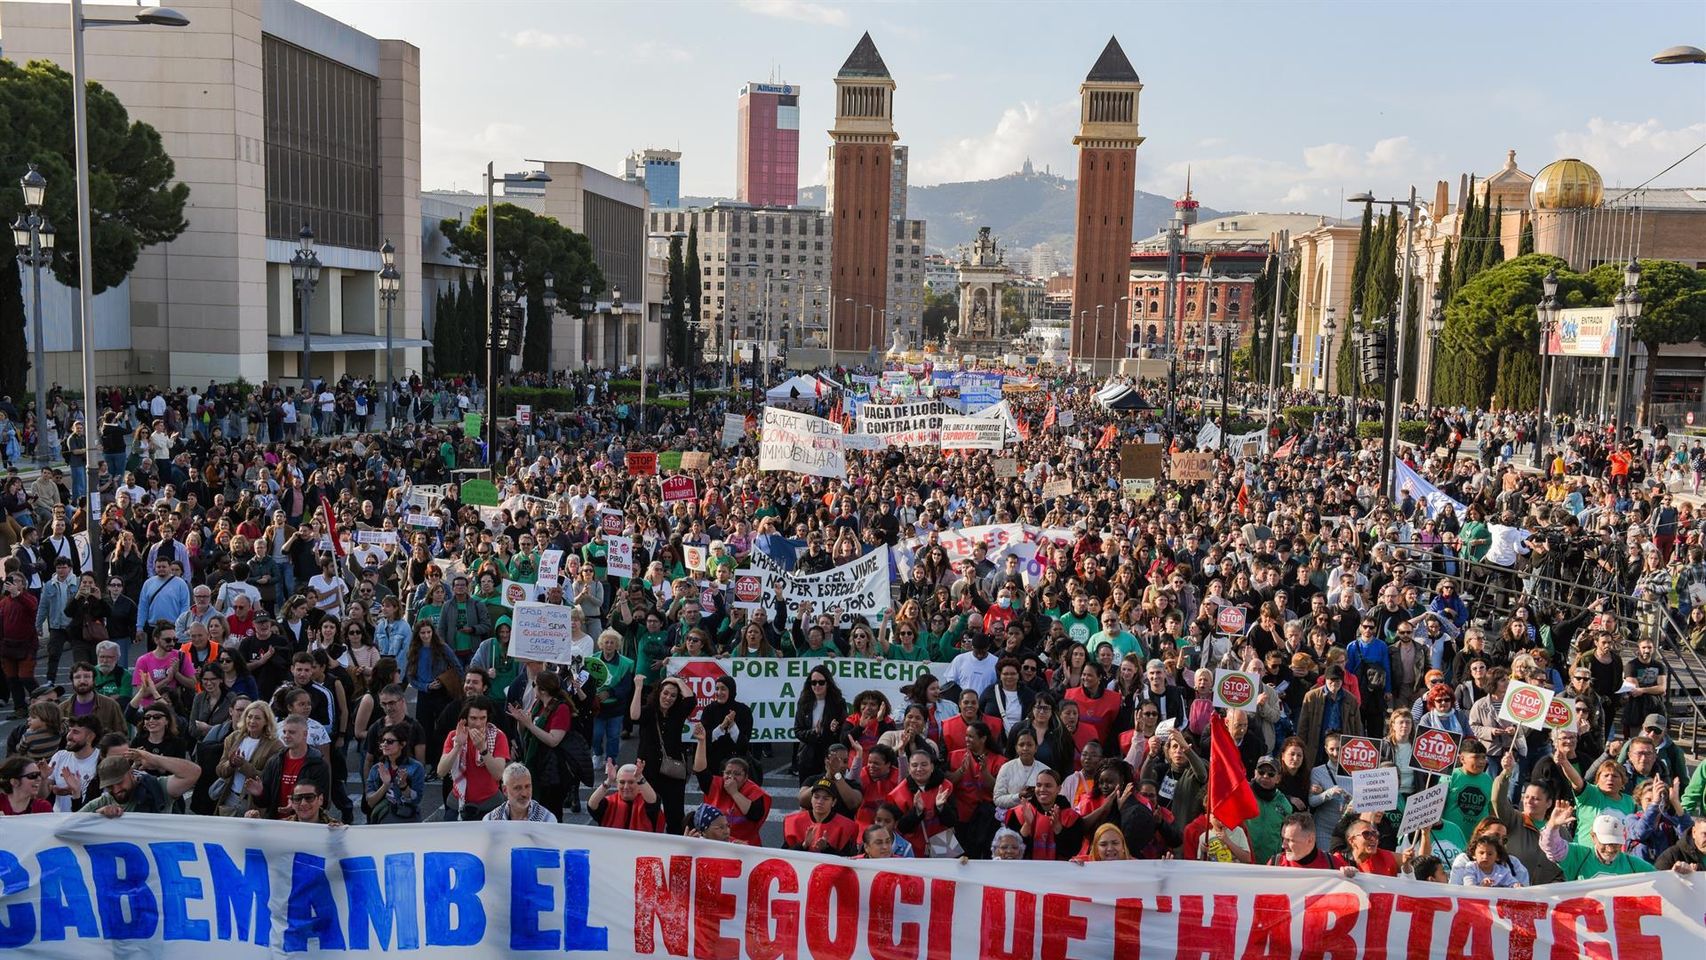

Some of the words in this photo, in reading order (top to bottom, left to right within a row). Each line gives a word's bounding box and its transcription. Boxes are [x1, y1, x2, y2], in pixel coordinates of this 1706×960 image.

[757, 84, 782, 93] Allianz
[1581, 316, 1603, 325] ENTRADA
[864, 405, 892, 419] VAGA
[893, 405, 909, 418] DE
[866, 419, 911, 434] CONTRA
[913, 417, 926, 430] LA
[630, 456, 653, 465] STOP
[762, 444, 838, 469] IMMOBILIARI
[669, 478, 687, 488] STOP
[604, 519, 621, 528] STOP
[609, 540, 619, 548] NO
[609, 547, 618, 555] ME
[609, 555, 623, 564] PIRO
[609, 562, 631, 571] VAMPIRO
[851, 555, 879, 580] VIVRE
[737, 582, 759, 591] STOP
[766, 573, 787, 590] NO
[790, 581, 813, 597] PER
[818, 578, 867, 598] ESPECULAR
[508, 588, 523, 598] STOP
[1220, 613, 1243, 622] STOP
[1071, 628, 1087, 637] STOP
[732, 660, 779, 678] POR
[787, 660, 810, 678] EL
[823, 660, 930, 682] DERECHO
[780, 682, 795, 698] A
[1224, 680, 1250, 692] STOP
[1514, 693, 1542, 707] STOP
[1550, 705, 1568, 716] TOP
[1418, 737, 1454, 756] STOP
[1343, 747, 1376, 762] STOP
[1416, 750, 1451, 763] DESAHUCIOS
[1343, 759, 1374, 768] DESAHUCIOS
[1413, 788, 1442, 805] 20.000
[1461, 791, 1485, 805] STOP
[1407, 808, 1438, 824] SOCIALES
[1433, 848, 1460, 862] SOP
[283, 852, 486, 952] AMB
[510, 847, 608, 952] EL
[634, 855, 956, 960] NEGOCI
